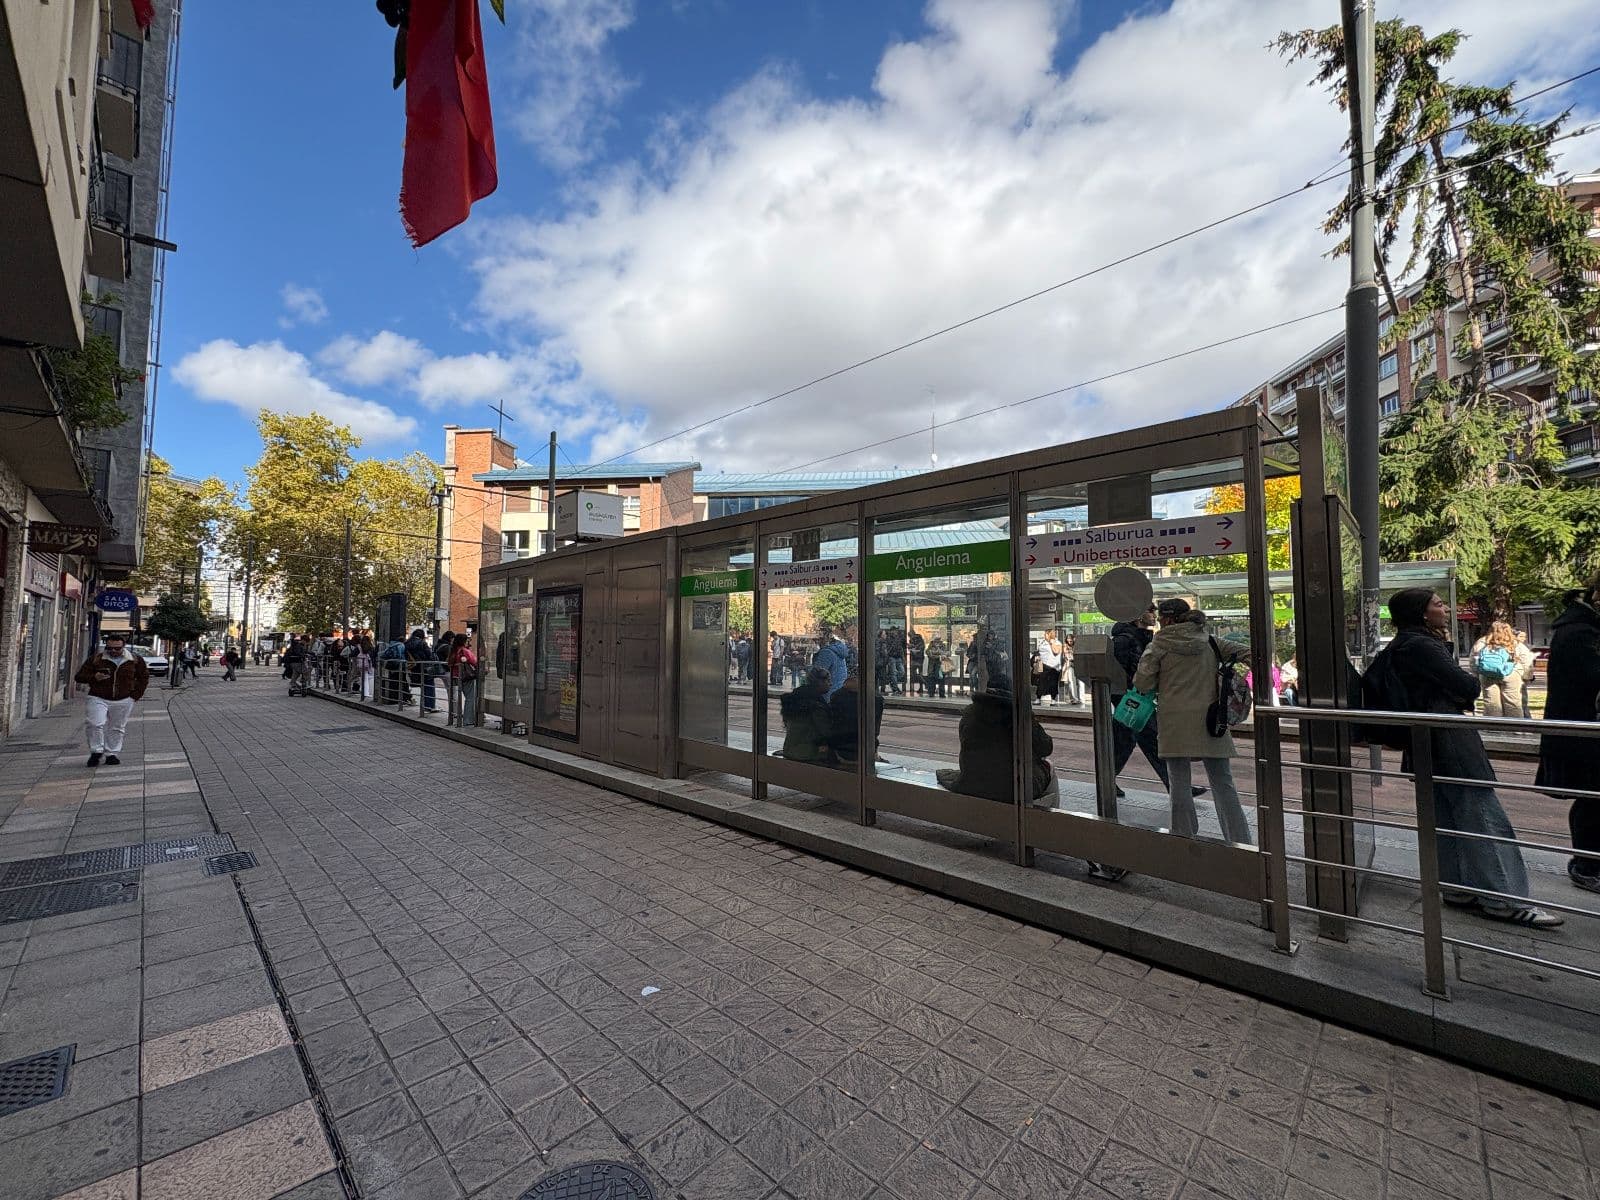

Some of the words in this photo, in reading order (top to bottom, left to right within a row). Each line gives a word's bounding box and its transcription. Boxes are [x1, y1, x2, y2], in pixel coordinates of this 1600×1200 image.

[1085, 528, 1154, 544] Salburua
[895, 551, 971, 573] Angulema
[1064, 544, 1178, 563] Unibertsitatea
[789, 564, 820, 576] Salburua
[693, 576, 738, 593] Angulema
